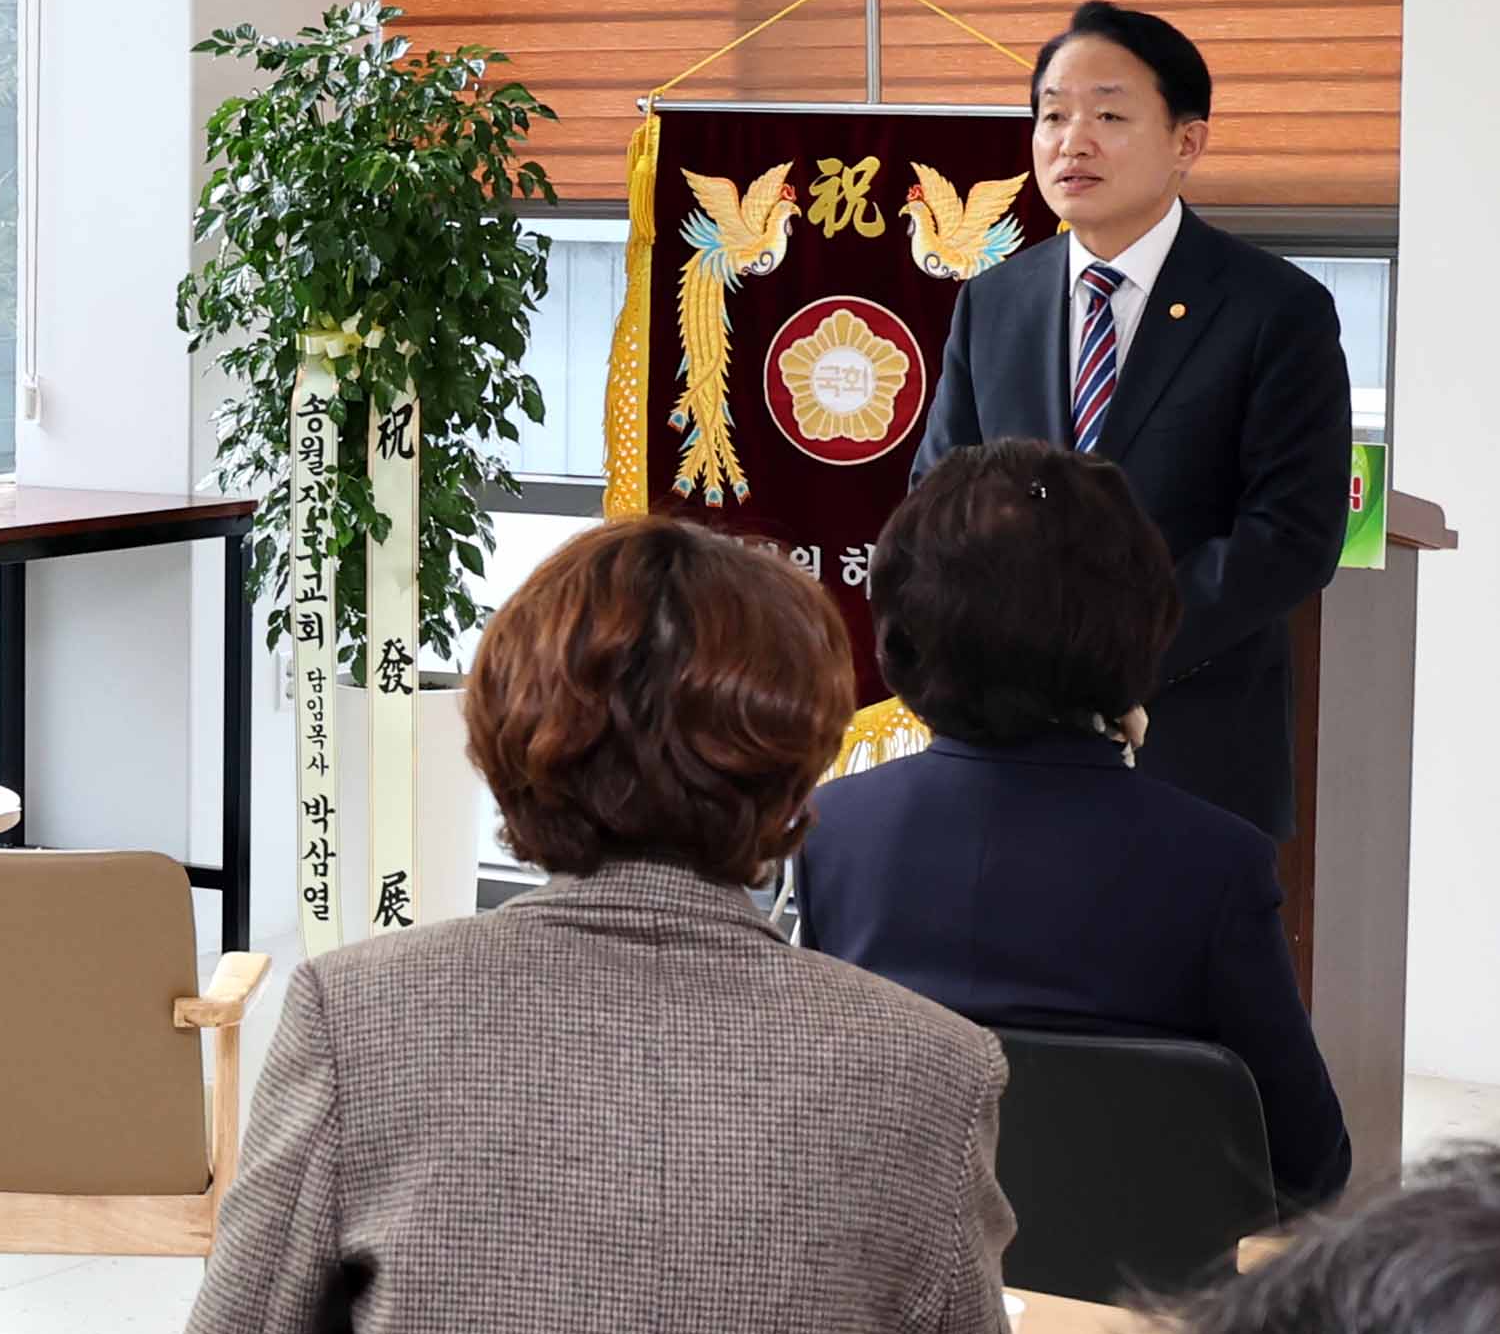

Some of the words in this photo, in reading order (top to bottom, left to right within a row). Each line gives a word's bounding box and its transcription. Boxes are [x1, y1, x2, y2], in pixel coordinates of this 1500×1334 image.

[807, 155, 886, 239] 祝
[815, 365, 869, 398] 국회
[305, 667, 330, 776] 담임목사
[301, 793, 336, 921] 박삼열
